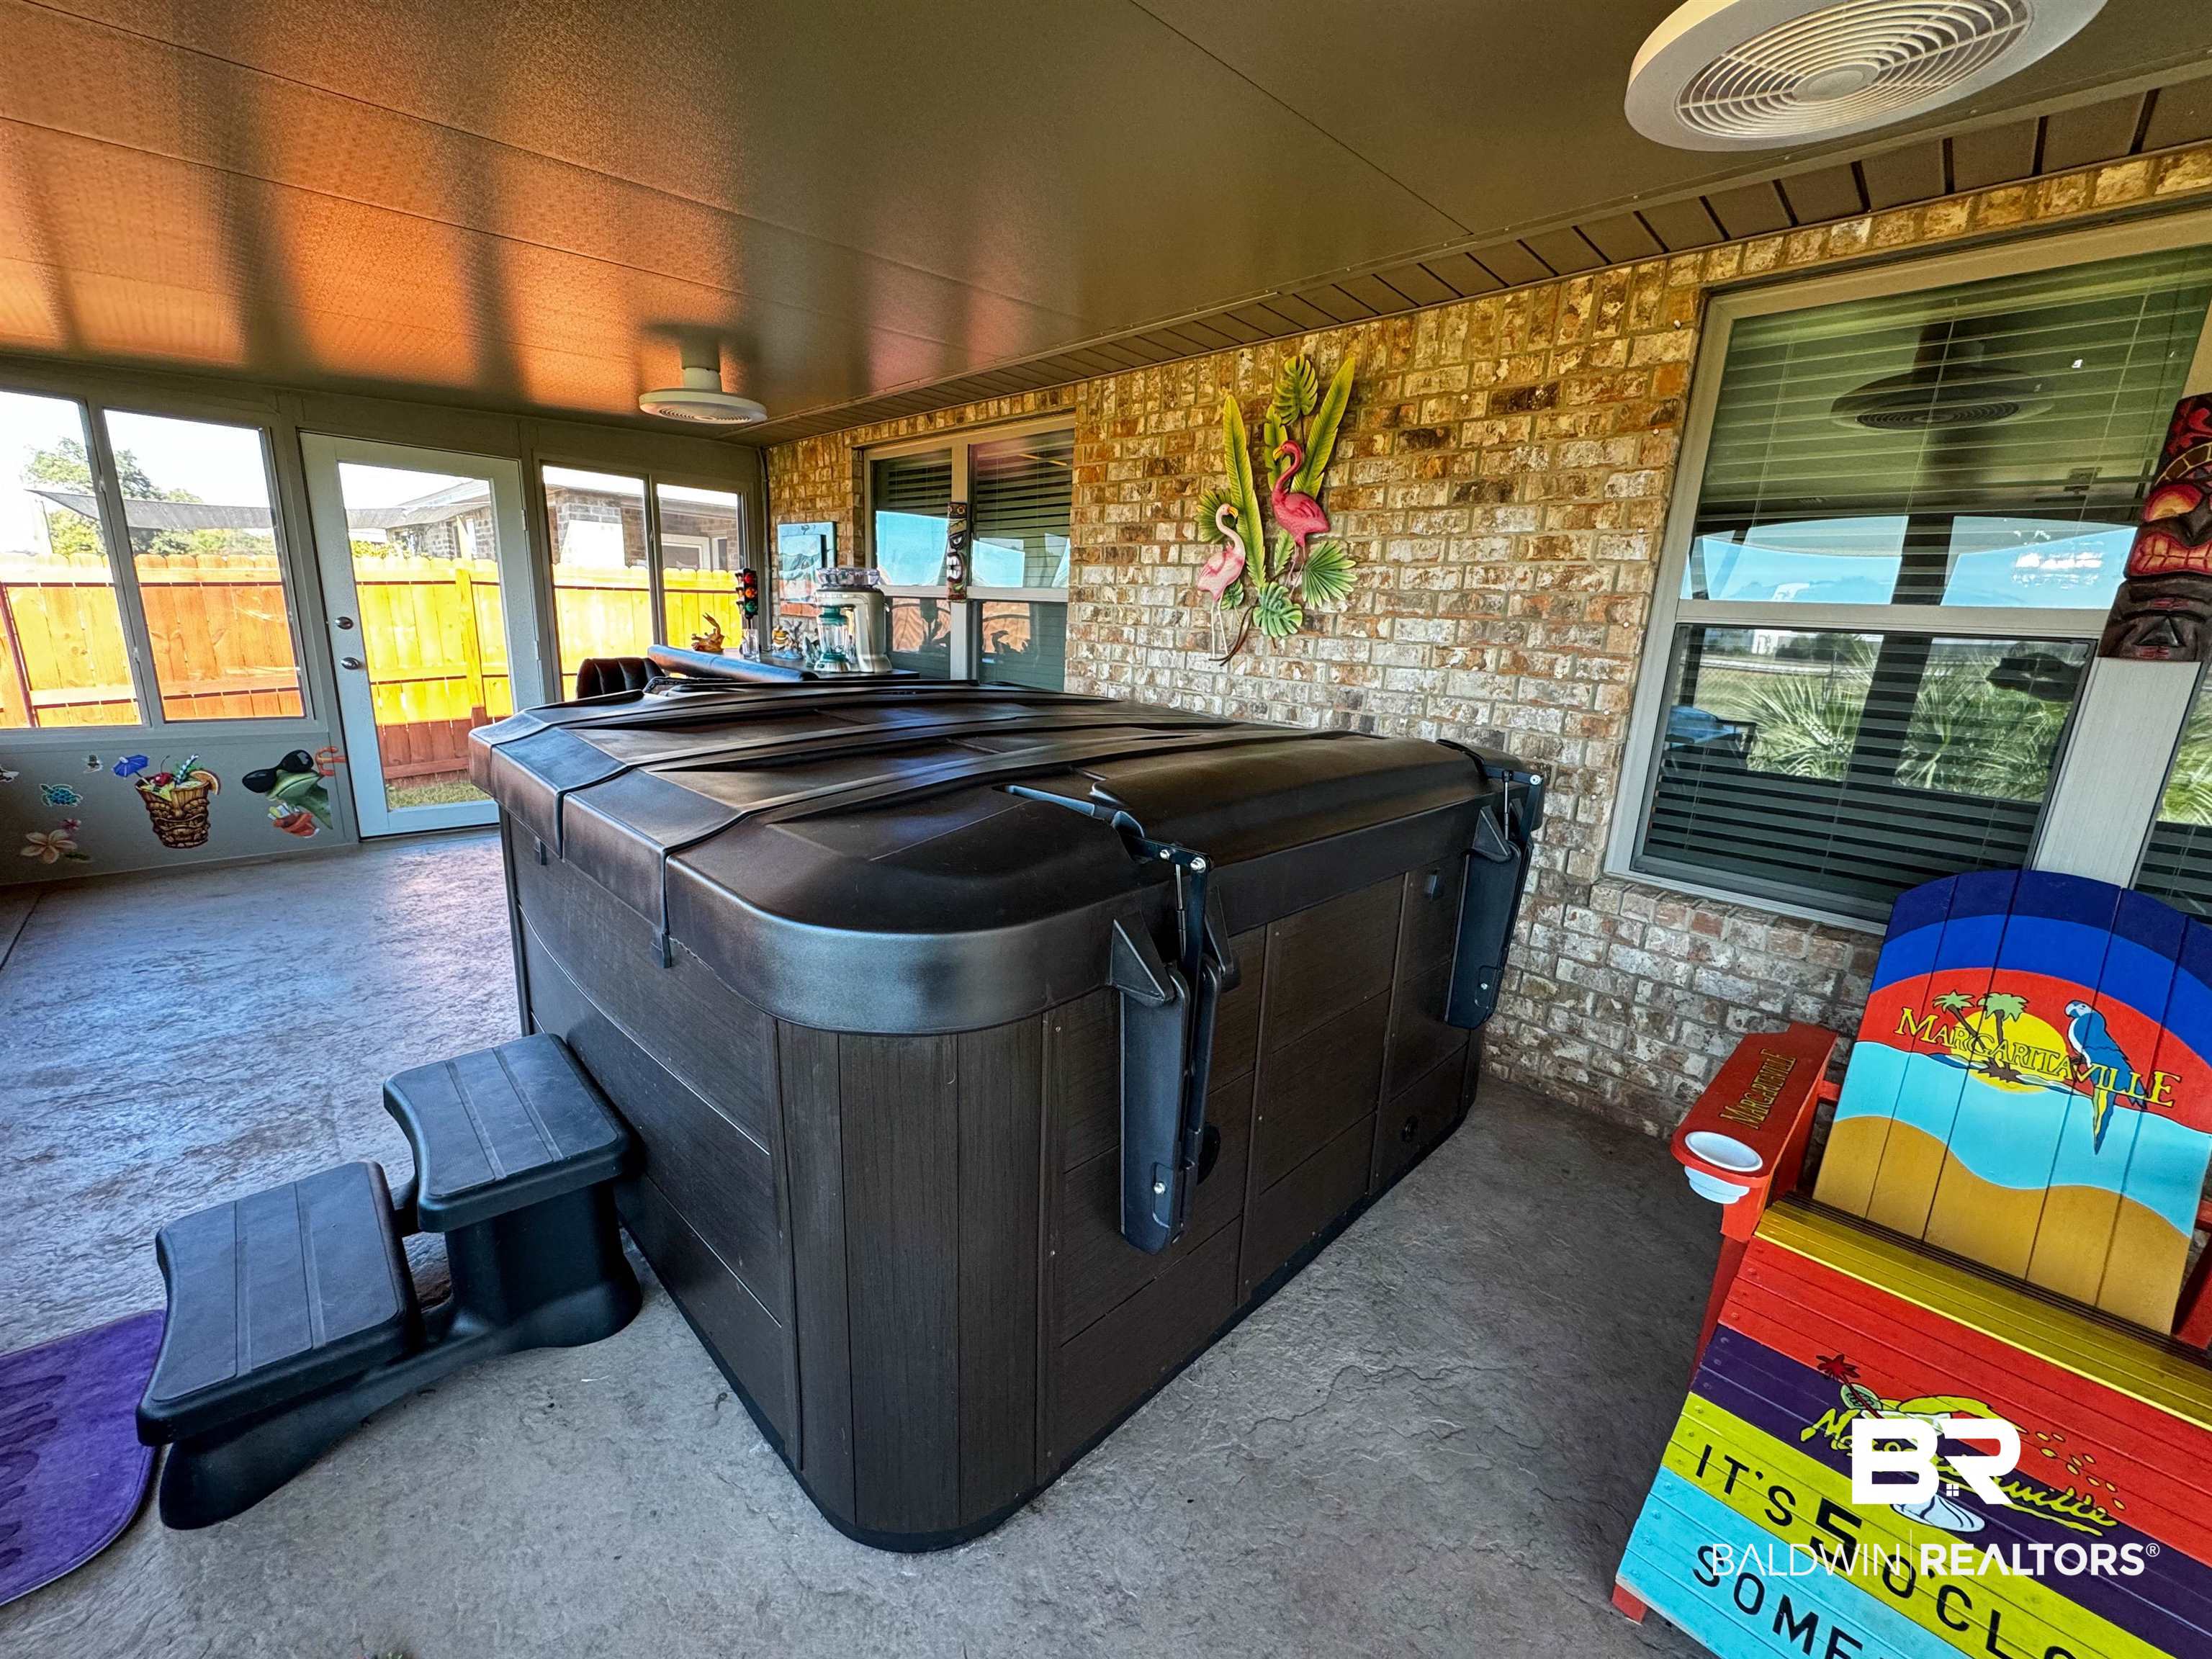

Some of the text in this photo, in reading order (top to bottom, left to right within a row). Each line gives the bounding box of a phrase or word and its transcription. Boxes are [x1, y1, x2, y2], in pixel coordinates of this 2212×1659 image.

[1718, 1048, 1798, 1130] MARGARITAVILLE
[1894, 1007, 2182, 1108] MARGARITAVILLE
[1694, 1444, 1797, 1527] IT'S
[1809, 1496, 1863, 1574] 5
[1692, 1545, 1885, 1659] SOME
